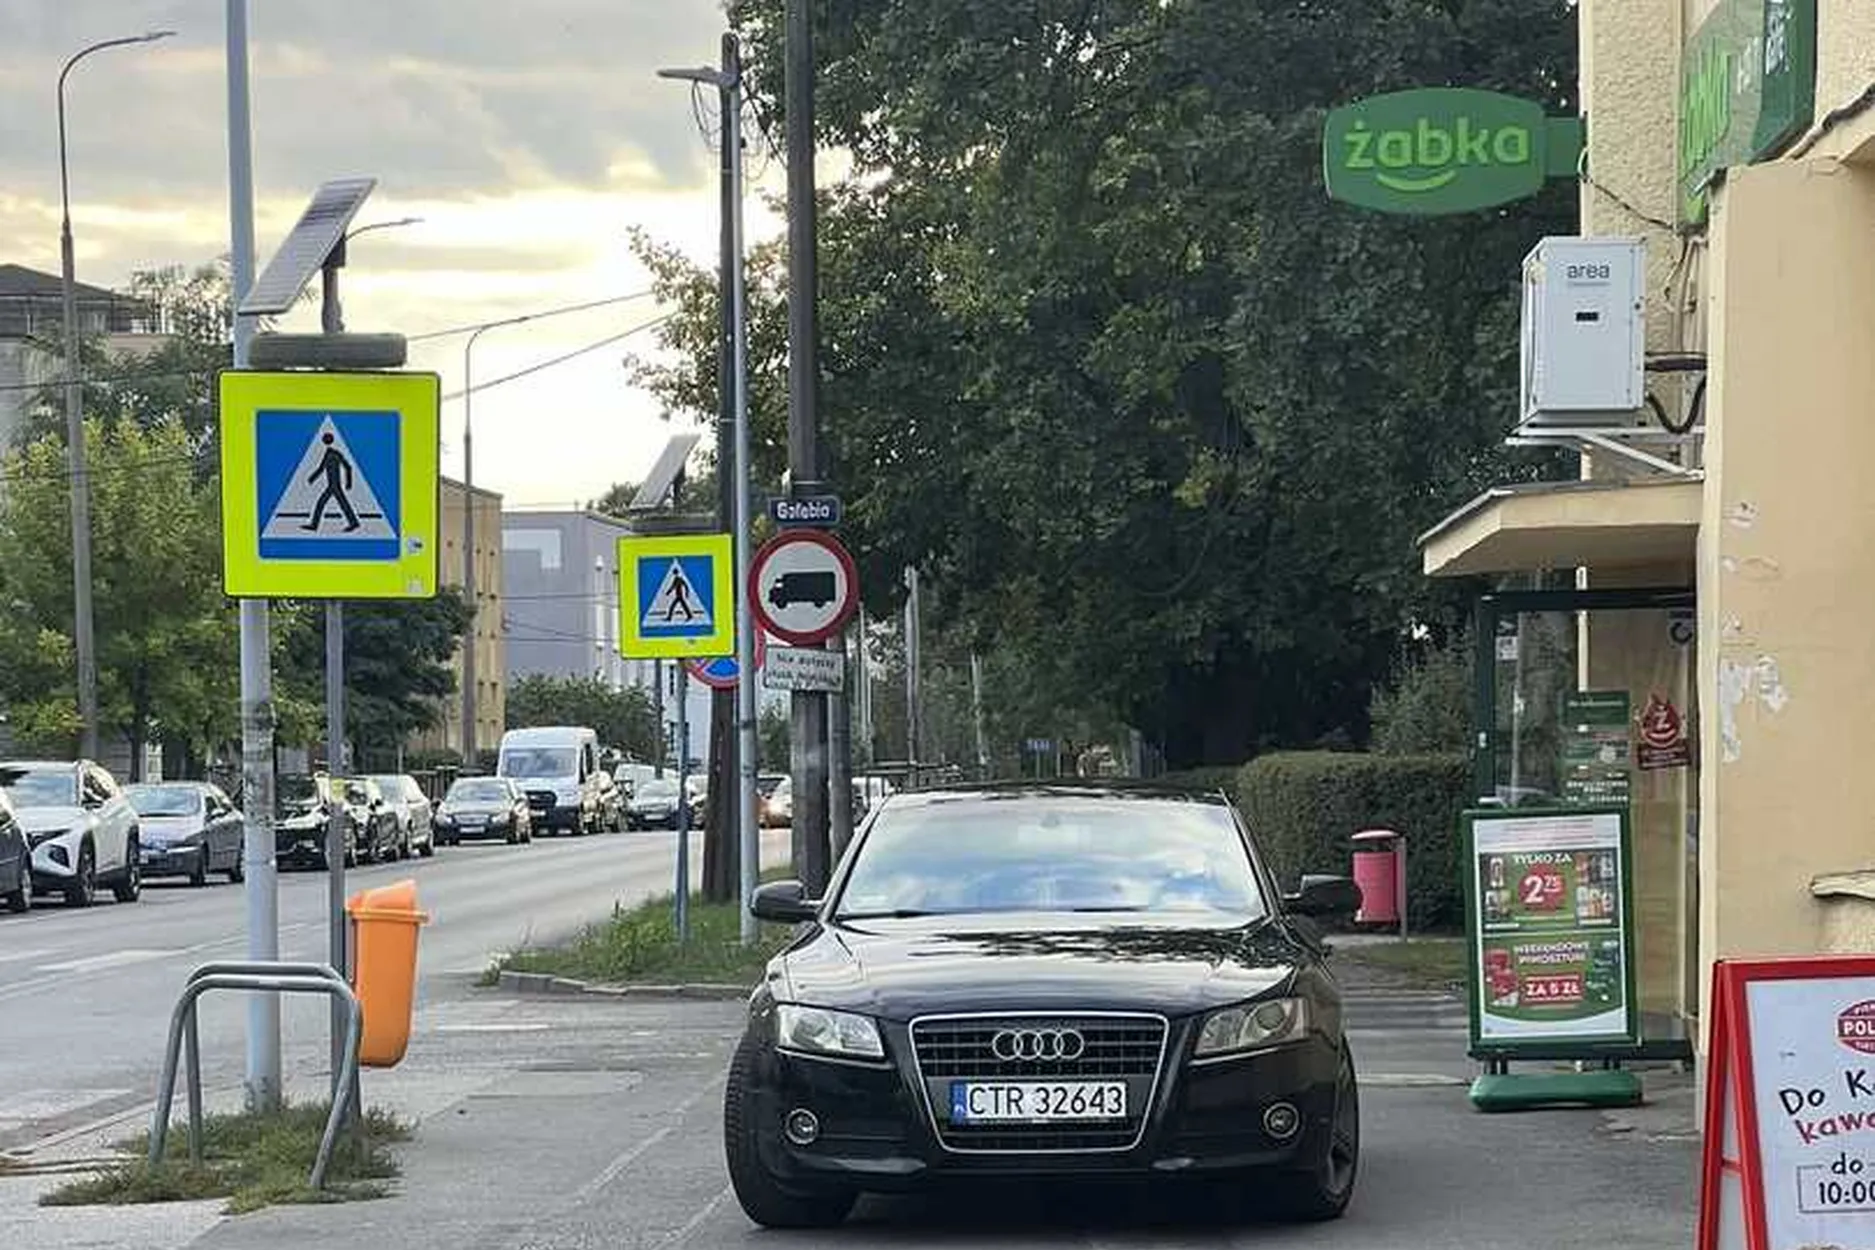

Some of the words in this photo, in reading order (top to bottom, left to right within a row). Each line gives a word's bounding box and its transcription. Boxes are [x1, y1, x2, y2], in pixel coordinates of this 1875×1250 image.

[1343, 119, 1530, 169] żabka
[1567, 265, 1610, 279] area
[1554, 852, 1573, 864] ZA
[1525, 982, 1547, 996] ZA
[969, 1086, 1025, 1115] CTR
[1035, 1086, 1123, 1115] 32643
[1779, 1088, 1826, 1116] Do
[1845, 1069, 1875, 1099] K
[1831, 1151, 1864, 1175] do
